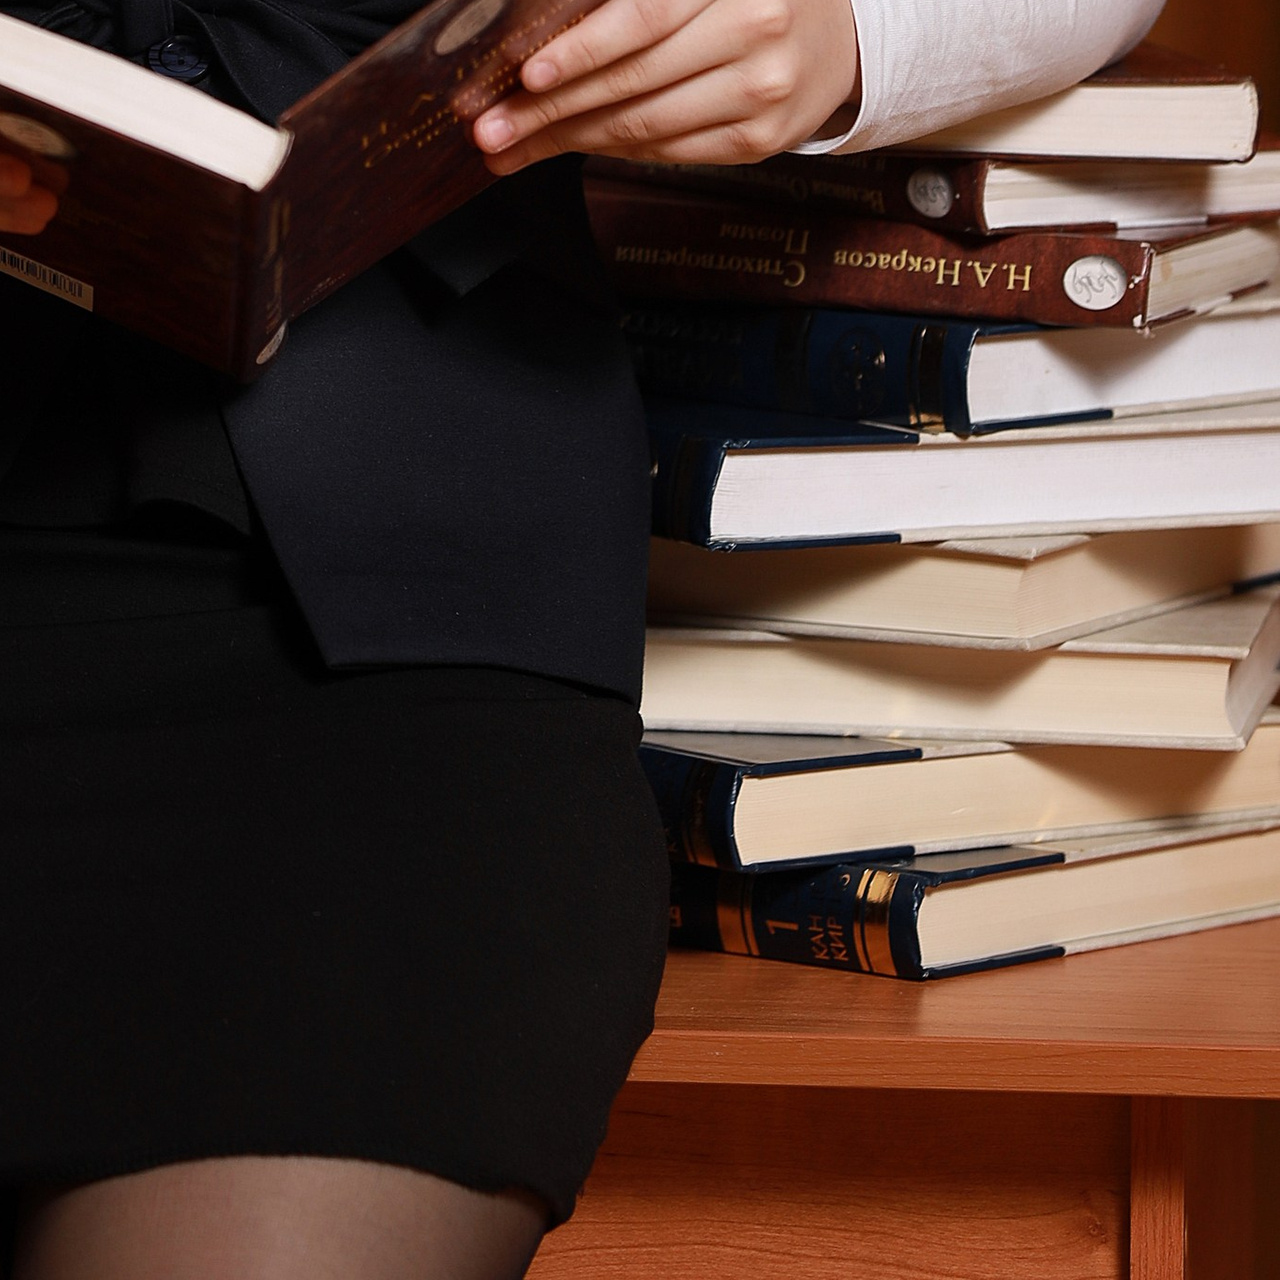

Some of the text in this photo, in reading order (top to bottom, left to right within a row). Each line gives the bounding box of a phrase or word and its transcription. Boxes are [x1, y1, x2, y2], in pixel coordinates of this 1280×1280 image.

[718, 222, 811, 255] Поэмы
[615, 245, 806, 288] Стихотворения
[833, 249, 961, 287] Некрасов
[765, 918, 800, 936] 1
